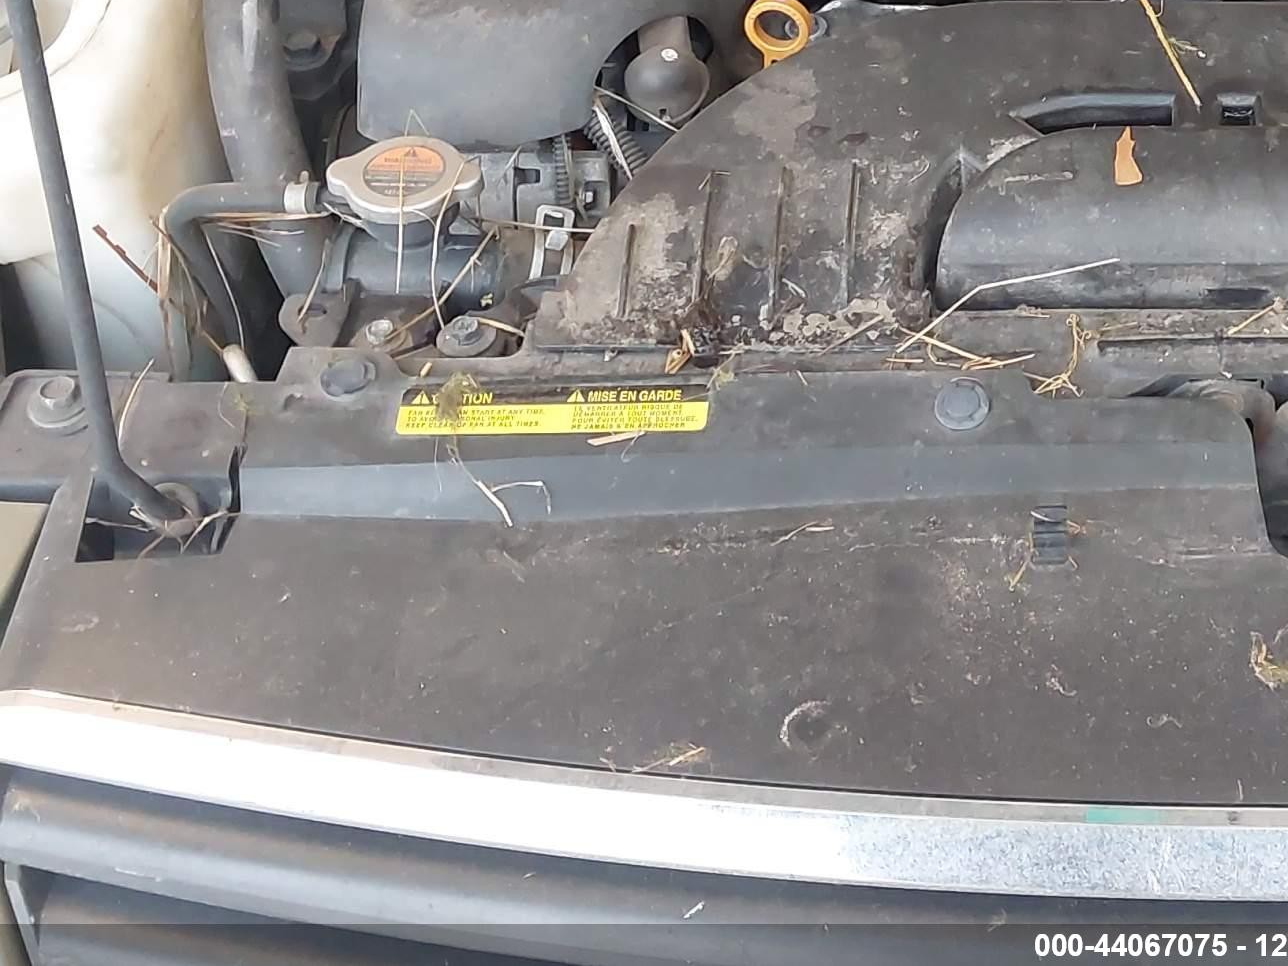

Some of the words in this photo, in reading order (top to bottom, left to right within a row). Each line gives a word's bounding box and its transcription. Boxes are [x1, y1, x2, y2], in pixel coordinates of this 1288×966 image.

[587, 390, 617, 402] MISE
[619, 390, 637, 402] EN
[638, 389, 682, 401] GARDE
